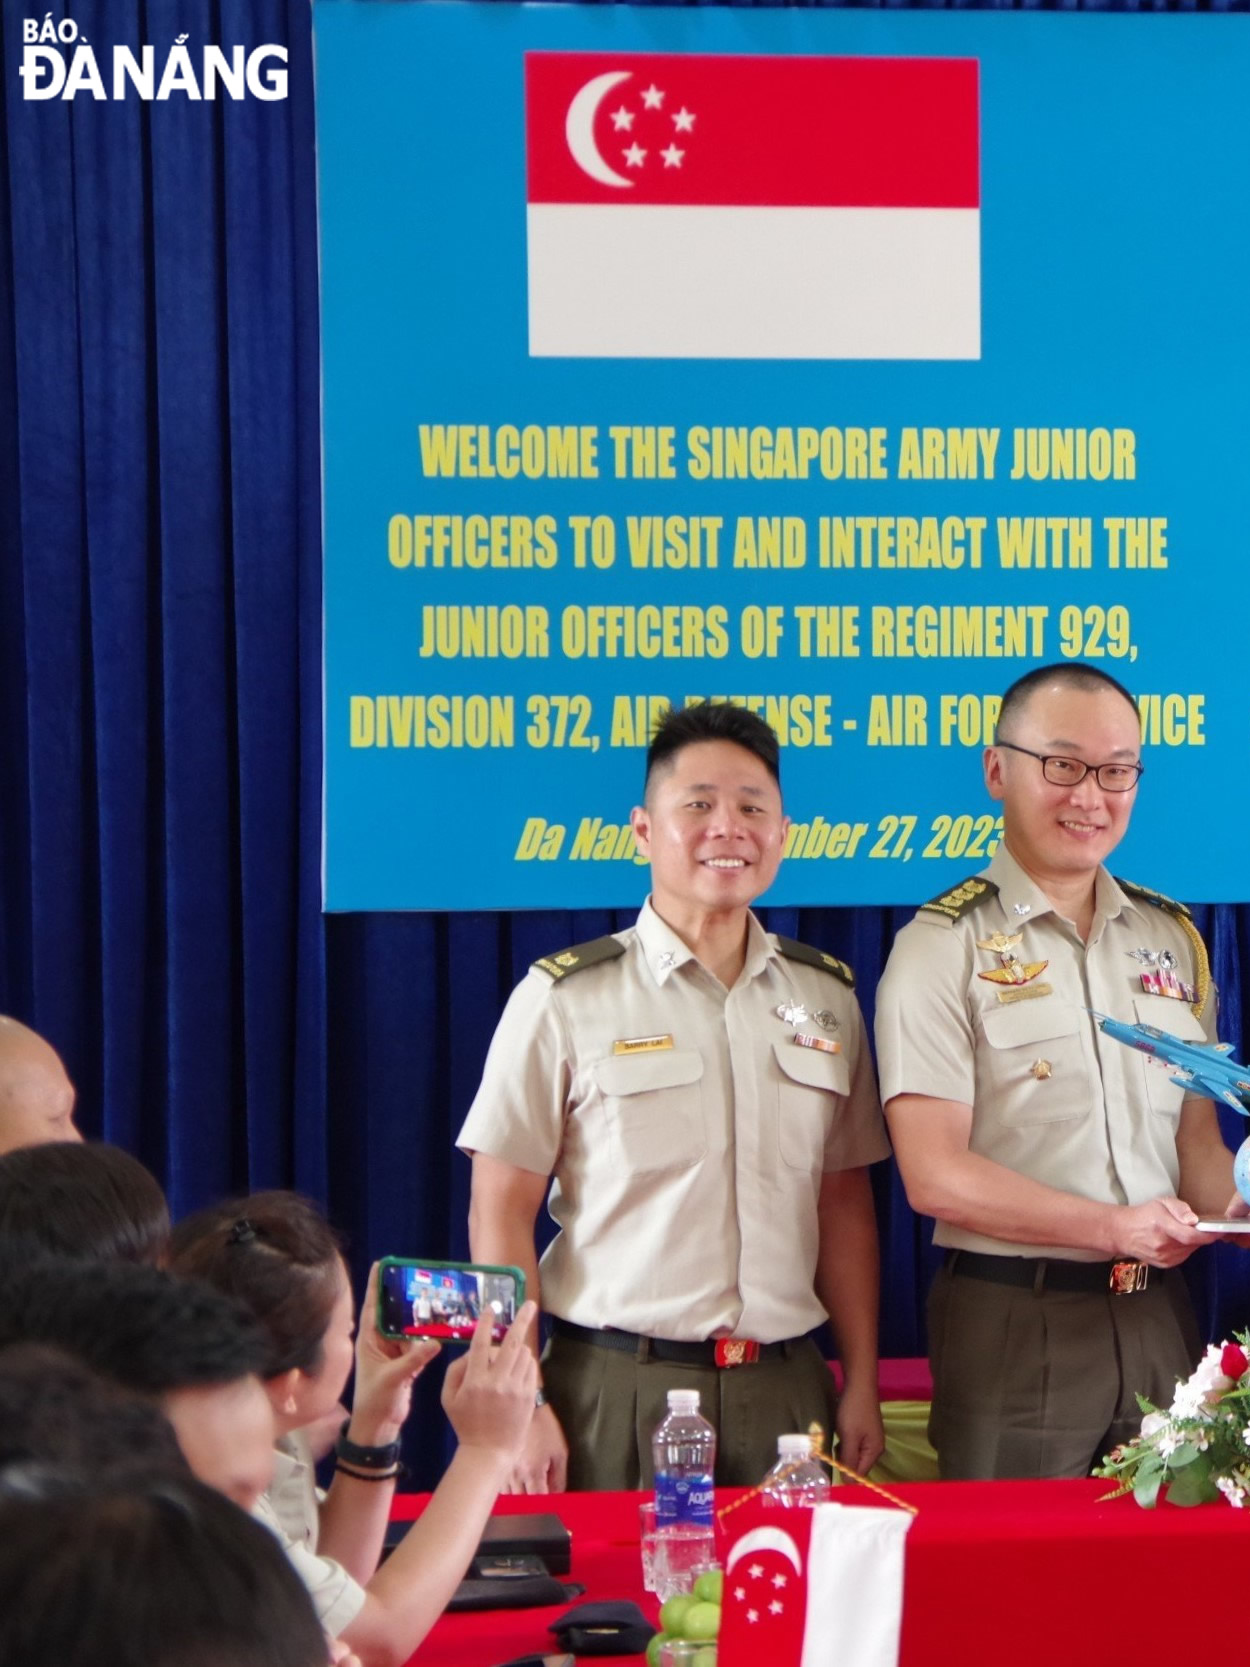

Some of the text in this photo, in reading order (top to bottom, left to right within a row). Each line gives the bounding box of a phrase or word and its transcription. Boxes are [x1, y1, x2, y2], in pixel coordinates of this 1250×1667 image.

[420, 425, 1136, 481] WELCOME THE SINGAPORE ARMY JUNIOR
[389, 515, 1167, 569] OFFICERS TO VISIT AND INTERACT WITH THE
[419, 605, 1138, 663] JUNIOR OFFICERS OF THE REGIMENT 929,
[350, 695, 514, 748] DIVISION
[527, 694, 600, 753] 372,
[867, 695, 927, 746] AIR
[514, 818, 566, 861] Da
[869, 815, 918, 863] 27,
